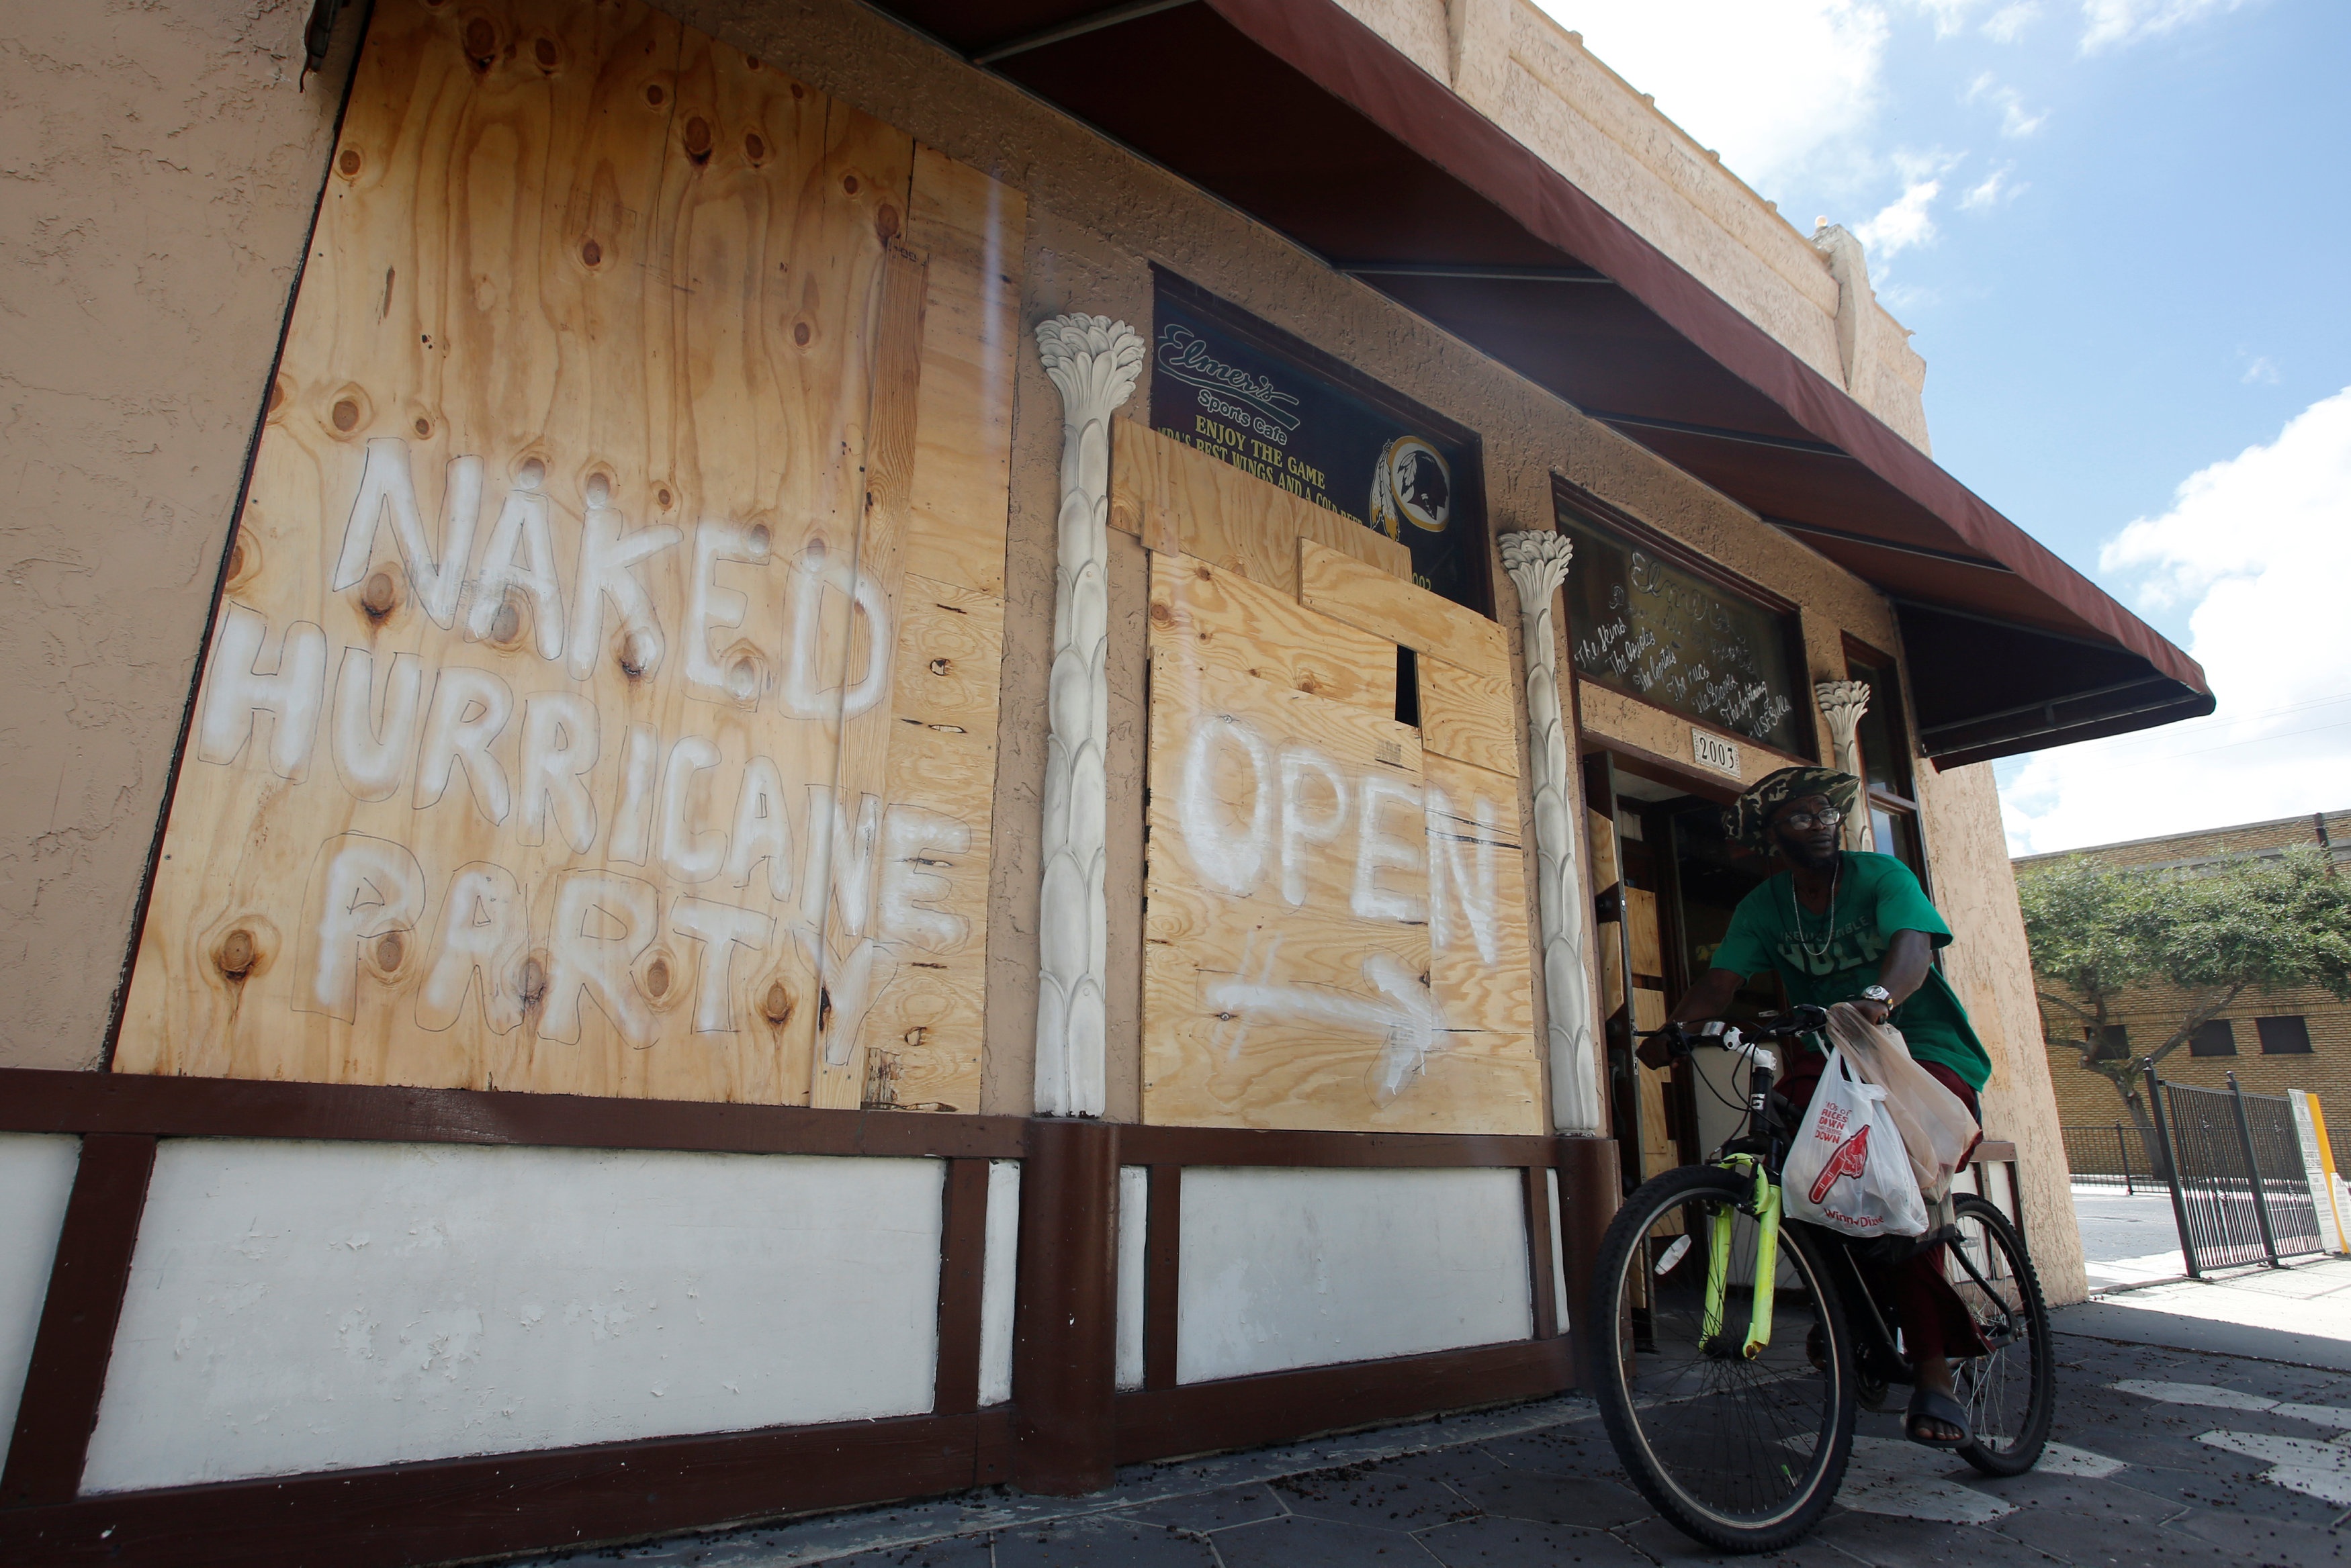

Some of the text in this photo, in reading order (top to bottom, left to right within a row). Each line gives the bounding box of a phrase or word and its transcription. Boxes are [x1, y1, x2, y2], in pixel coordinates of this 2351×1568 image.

[1158, 324, 1300, 406] Elmer's
[1198, 389, 1288, 445] Sports Cafe
[1195, 414, 1325, 490] ENJOY THE GAME
[1196, 439, 1228, 462] BEST
[1231, 451, 1274, 483] WINGS
[1278, 472, 1302, 498] AND
[1306, 487, 1312, 501] A
[332, 437, 893, 721] NAKED
[1574, 617, 1627, 668] The Skins
[1605, 651, 1629, 677] The
[1633, 667, 1654, 692] The
[1667, 676, 1687, 701] The
[1691, 690, 1710, 713] The
[1720, 698, 1739, 725] The
[197, 600, 973, 955] HURRICANE
[1699, 737, 1734, 768] 2003
[1180, 714, 1498, 965] OPEN
[294, 831, 895, 1066] PARTY
[1777, 927, 1888, 976] HULK
[1815, 1130, 1840, 1144] DOWN
